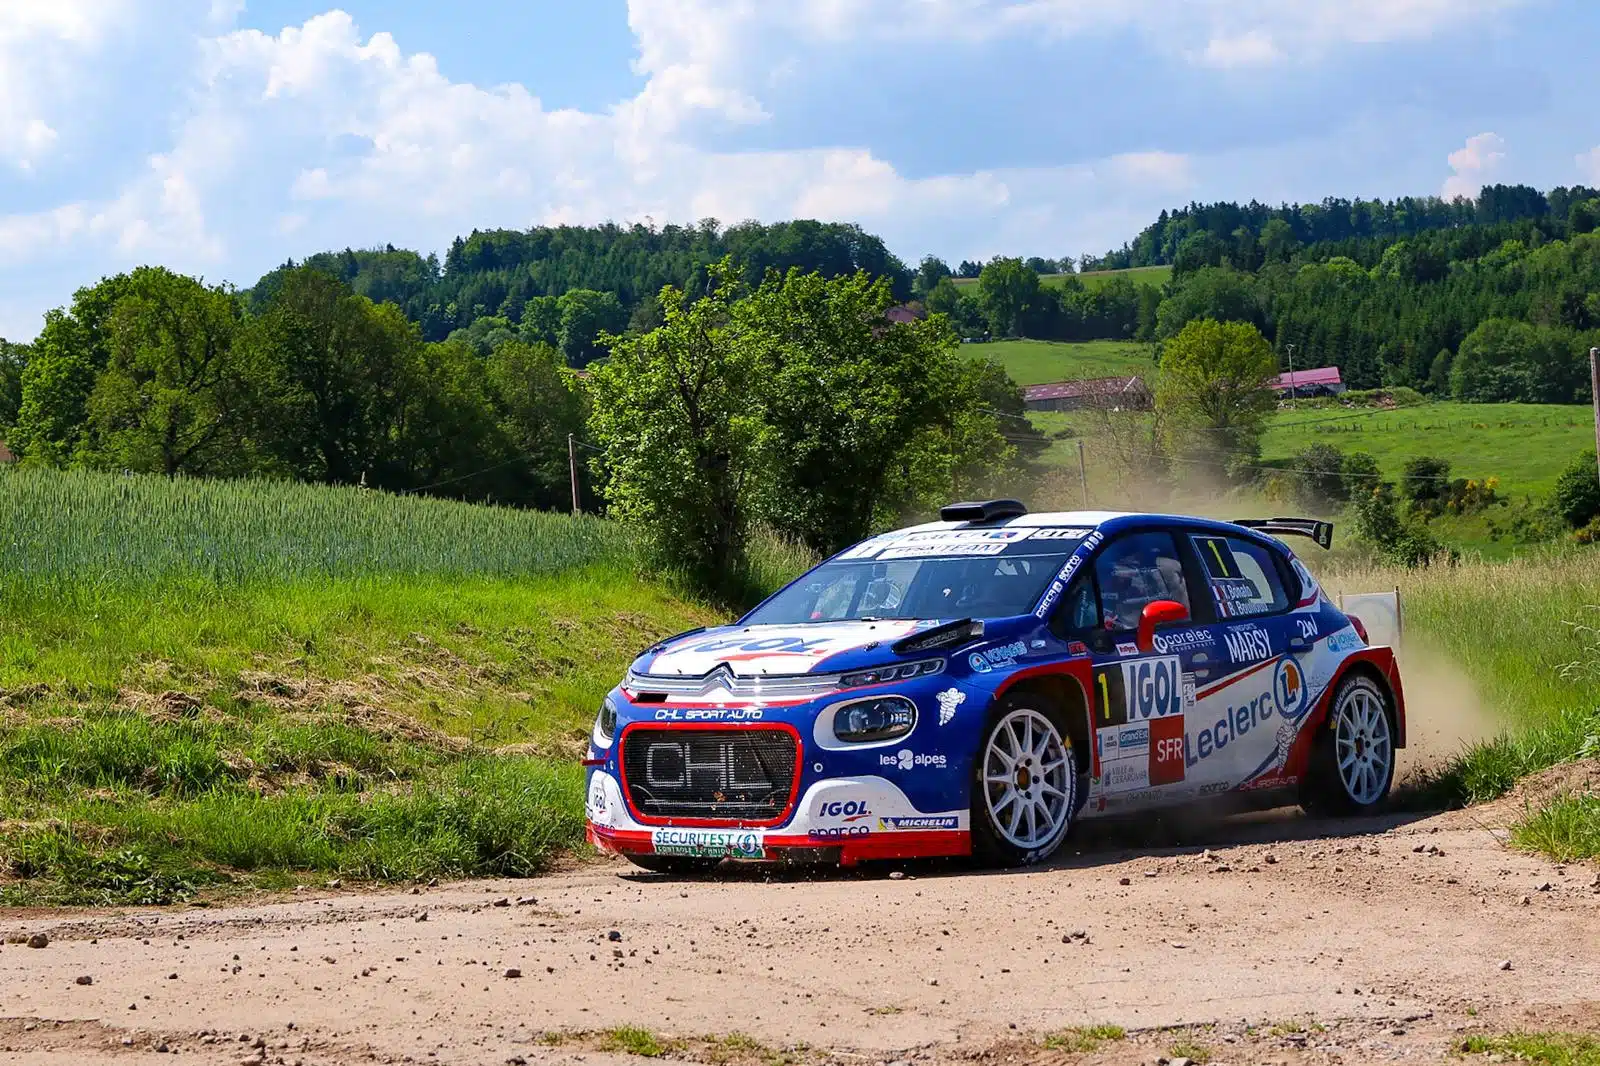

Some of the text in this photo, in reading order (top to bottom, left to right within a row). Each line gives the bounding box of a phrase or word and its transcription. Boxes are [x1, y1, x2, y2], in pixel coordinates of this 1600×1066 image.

[1207, 540, 1229, 577] 1
[1166, 629, 1212, 645] corelec
[1223, 628, 1273, 664] MARSY
[1098, 673, 1110, 719] 1
[1129, 660, 1180, 720] IGOL
[655, 709, 683, 720] CHL
[1184, 690, 1273, 768] Leclerc
[646, 742, 773, 789] CHL
[879, 753, 898, 765] les
[914, 753, 947, 767] alpes
[1156, 737, 1184, 762] SFR
[898, 818, 955, 827] MICHELIN
